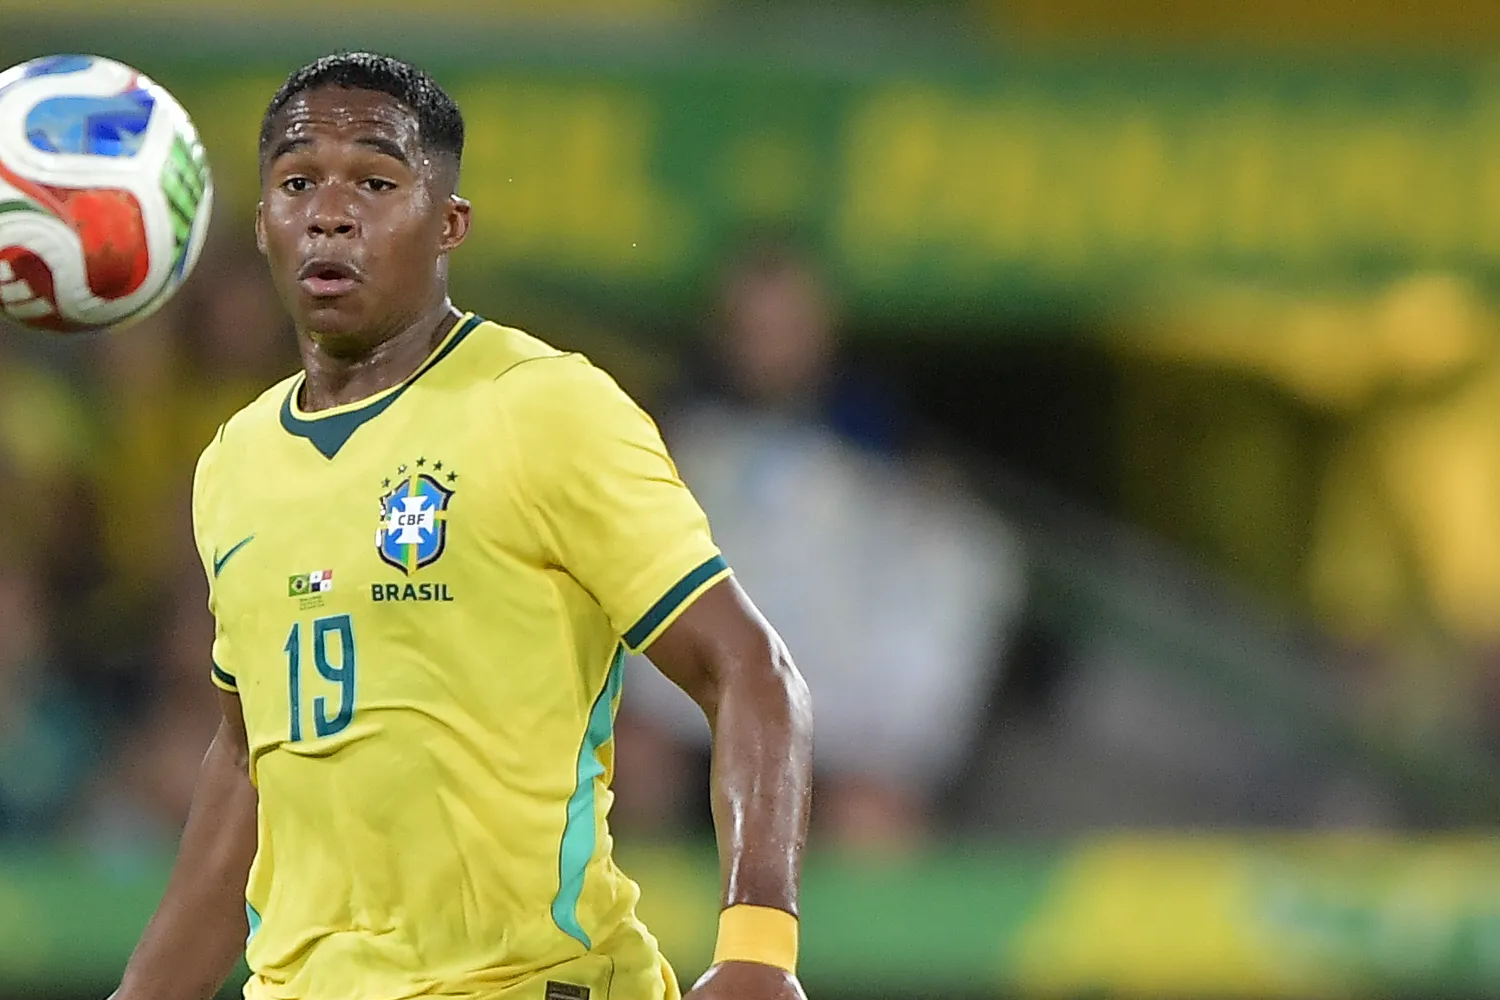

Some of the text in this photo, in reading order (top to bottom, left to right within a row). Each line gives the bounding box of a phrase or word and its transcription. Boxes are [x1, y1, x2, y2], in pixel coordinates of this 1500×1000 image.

[398, 513, 425, 526] CBF
[371, 583, 454, 601] BRASIL
[283, 614, 355, 742] 19
